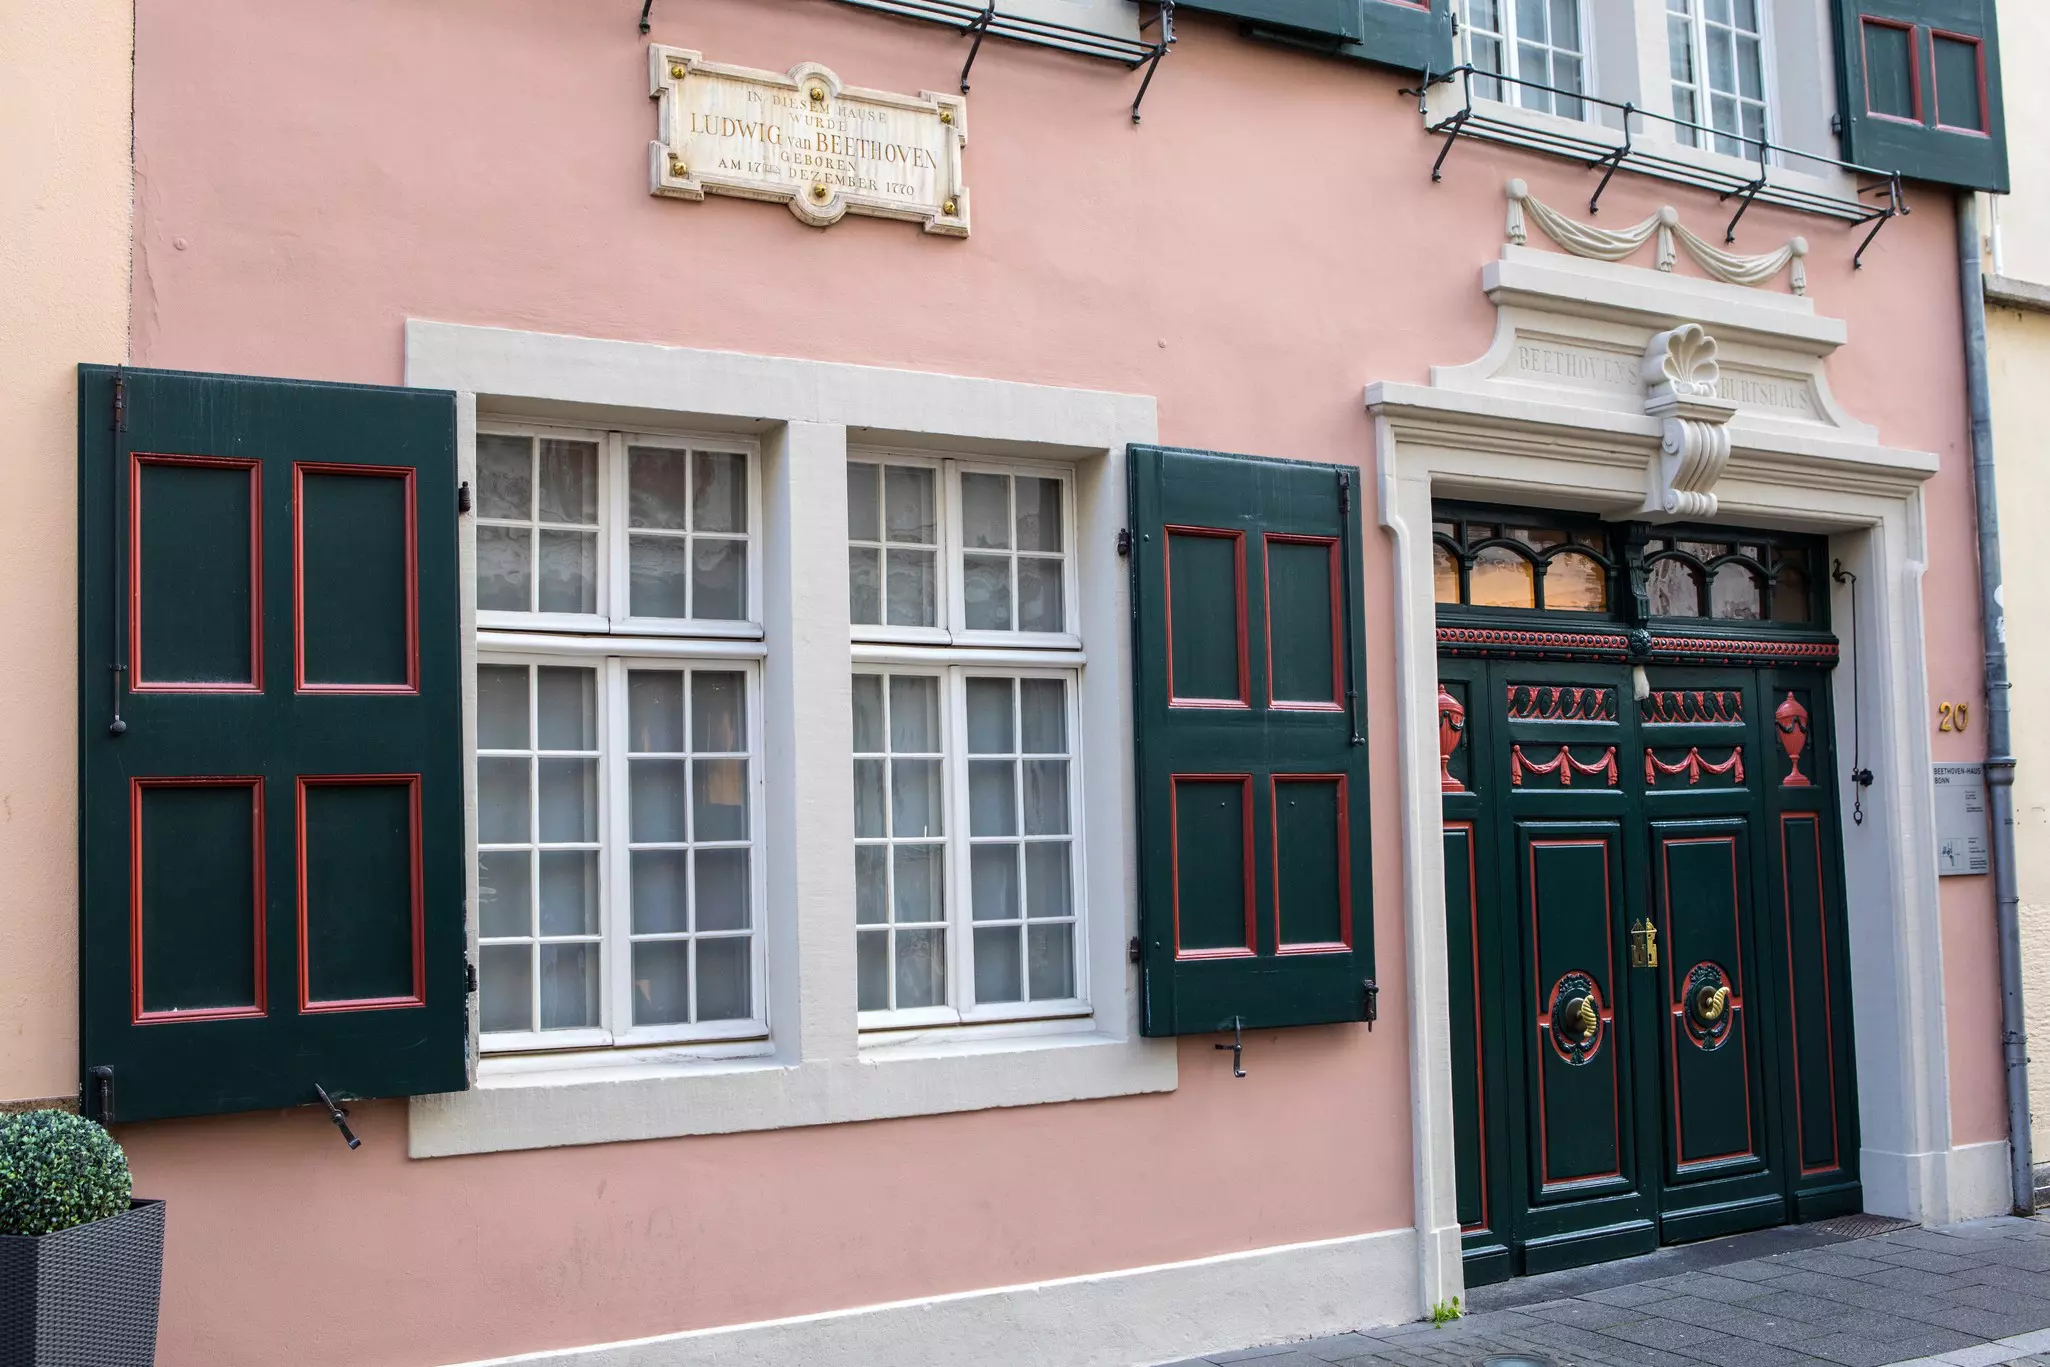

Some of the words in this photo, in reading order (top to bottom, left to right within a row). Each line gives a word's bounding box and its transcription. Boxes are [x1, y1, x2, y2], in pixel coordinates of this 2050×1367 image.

[748, 91, 762, 101] IN
[773, 95, 830, 114] DIESEM
[838, 106, 887, 123] HAUSE
[789, 112, 848, 131] WURDE
[691, 112, 781, 145] LUDWIG
[788, 136, 811, 150] van
[816, 132, 937, 169] BEETHOVEN
[718, 158, 741, 170] AM
[789, 167, 878, 191] DEZEMBER
[886, 182, 914, 195] 1770
[780, 151, 856, 172] GEBOREN
[1519, 346, 1638, 385] BEETHOVENS
[1939, 702, 1968, 731] 20
[1934, 767, 1981, 775] BEETHOVEN-HAUS
